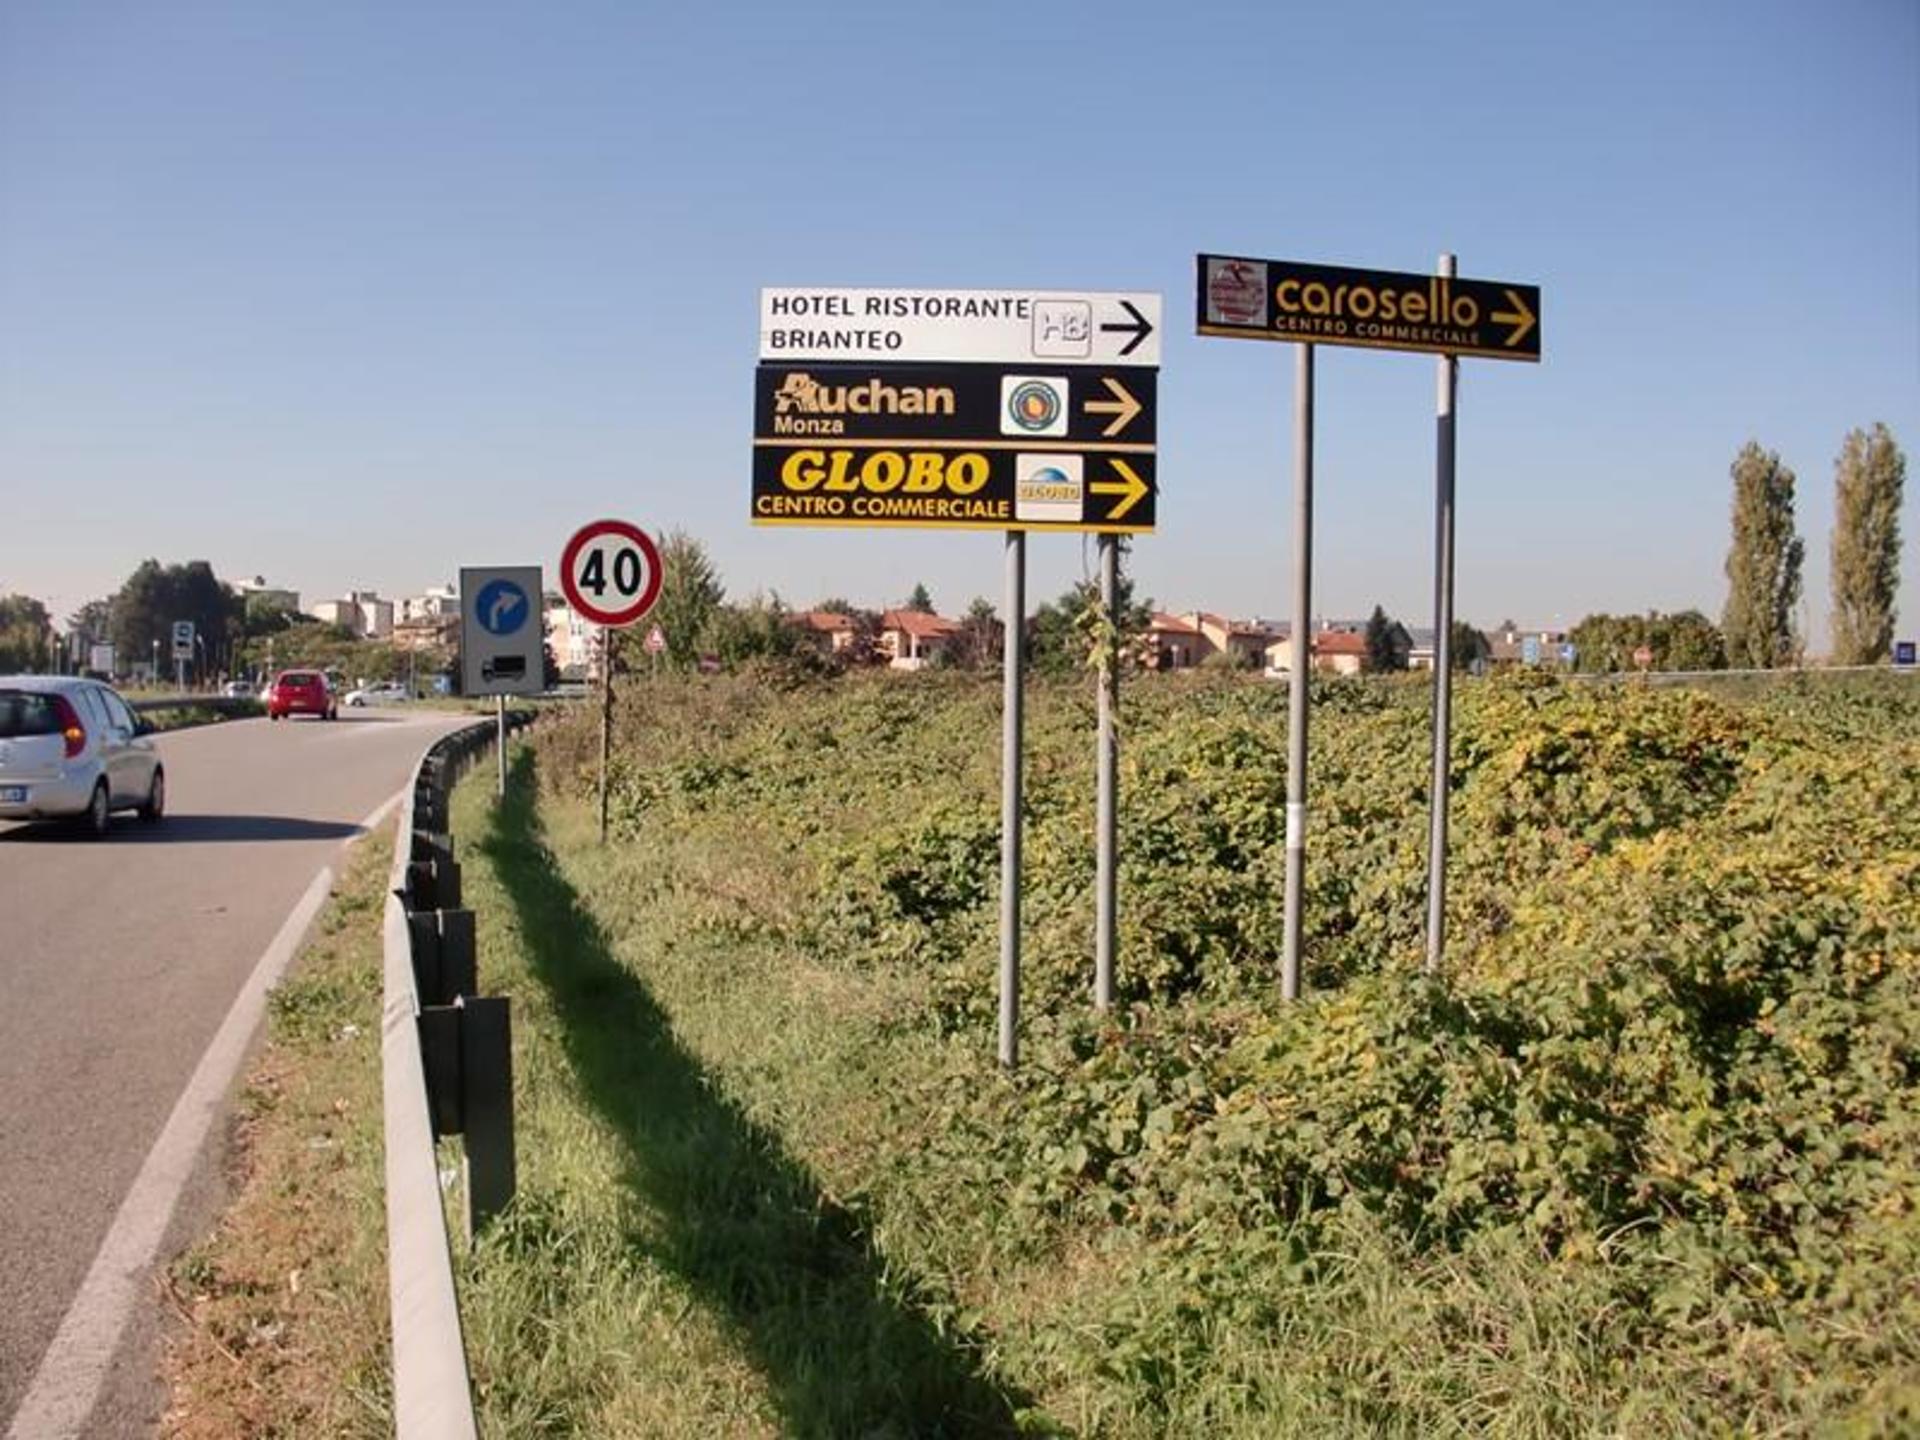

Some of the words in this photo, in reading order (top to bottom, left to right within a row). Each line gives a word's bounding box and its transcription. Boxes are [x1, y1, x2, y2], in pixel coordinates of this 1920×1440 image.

[771, 297, 855, 317] HOTEL
[865, 298, 1030, 319] RISTORANTE
[1275, 278, 1480, 328] carosello
[770, 329, 903, 350] BRIANTEO
[1275, 315, 1348, 335] CENTRO
[1354, 322, 1480, 346] COMMERCIALE
[774, 373, 955, 415] Auchan
[773, 415, 845, 434] Monza
[781, 450, 990, 494] GLOBO
[756, 495, 846, 517] CENTRO
[852, 497, 1010, 519] COMMERCIALE
[579, 547, 642, 596] 40
